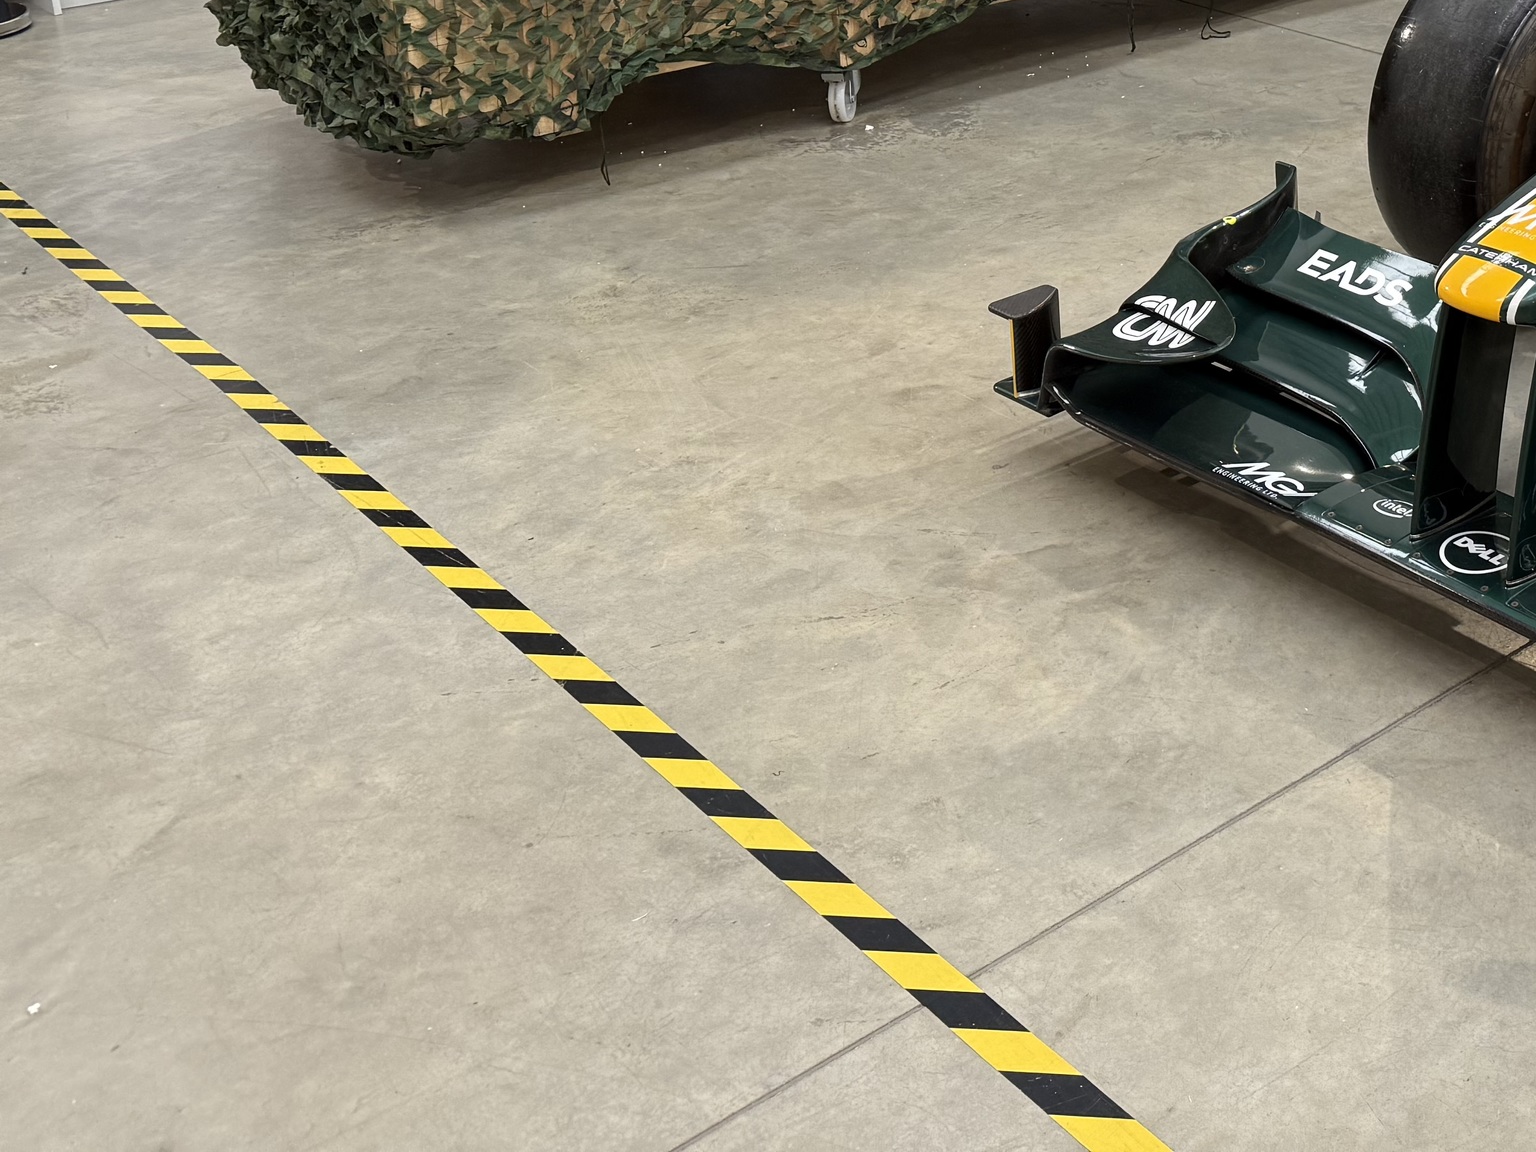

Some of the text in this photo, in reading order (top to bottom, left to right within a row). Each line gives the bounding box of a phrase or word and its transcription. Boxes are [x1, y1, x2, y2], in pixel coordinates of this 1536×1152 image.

[1297, 250, 1414, 308] EADS
[1111, 294, 1217, 350] CNN
[1211, 466, 1279, 500] ENGINEERING LTD.
[1452, 535, 1505, 566] DELL
